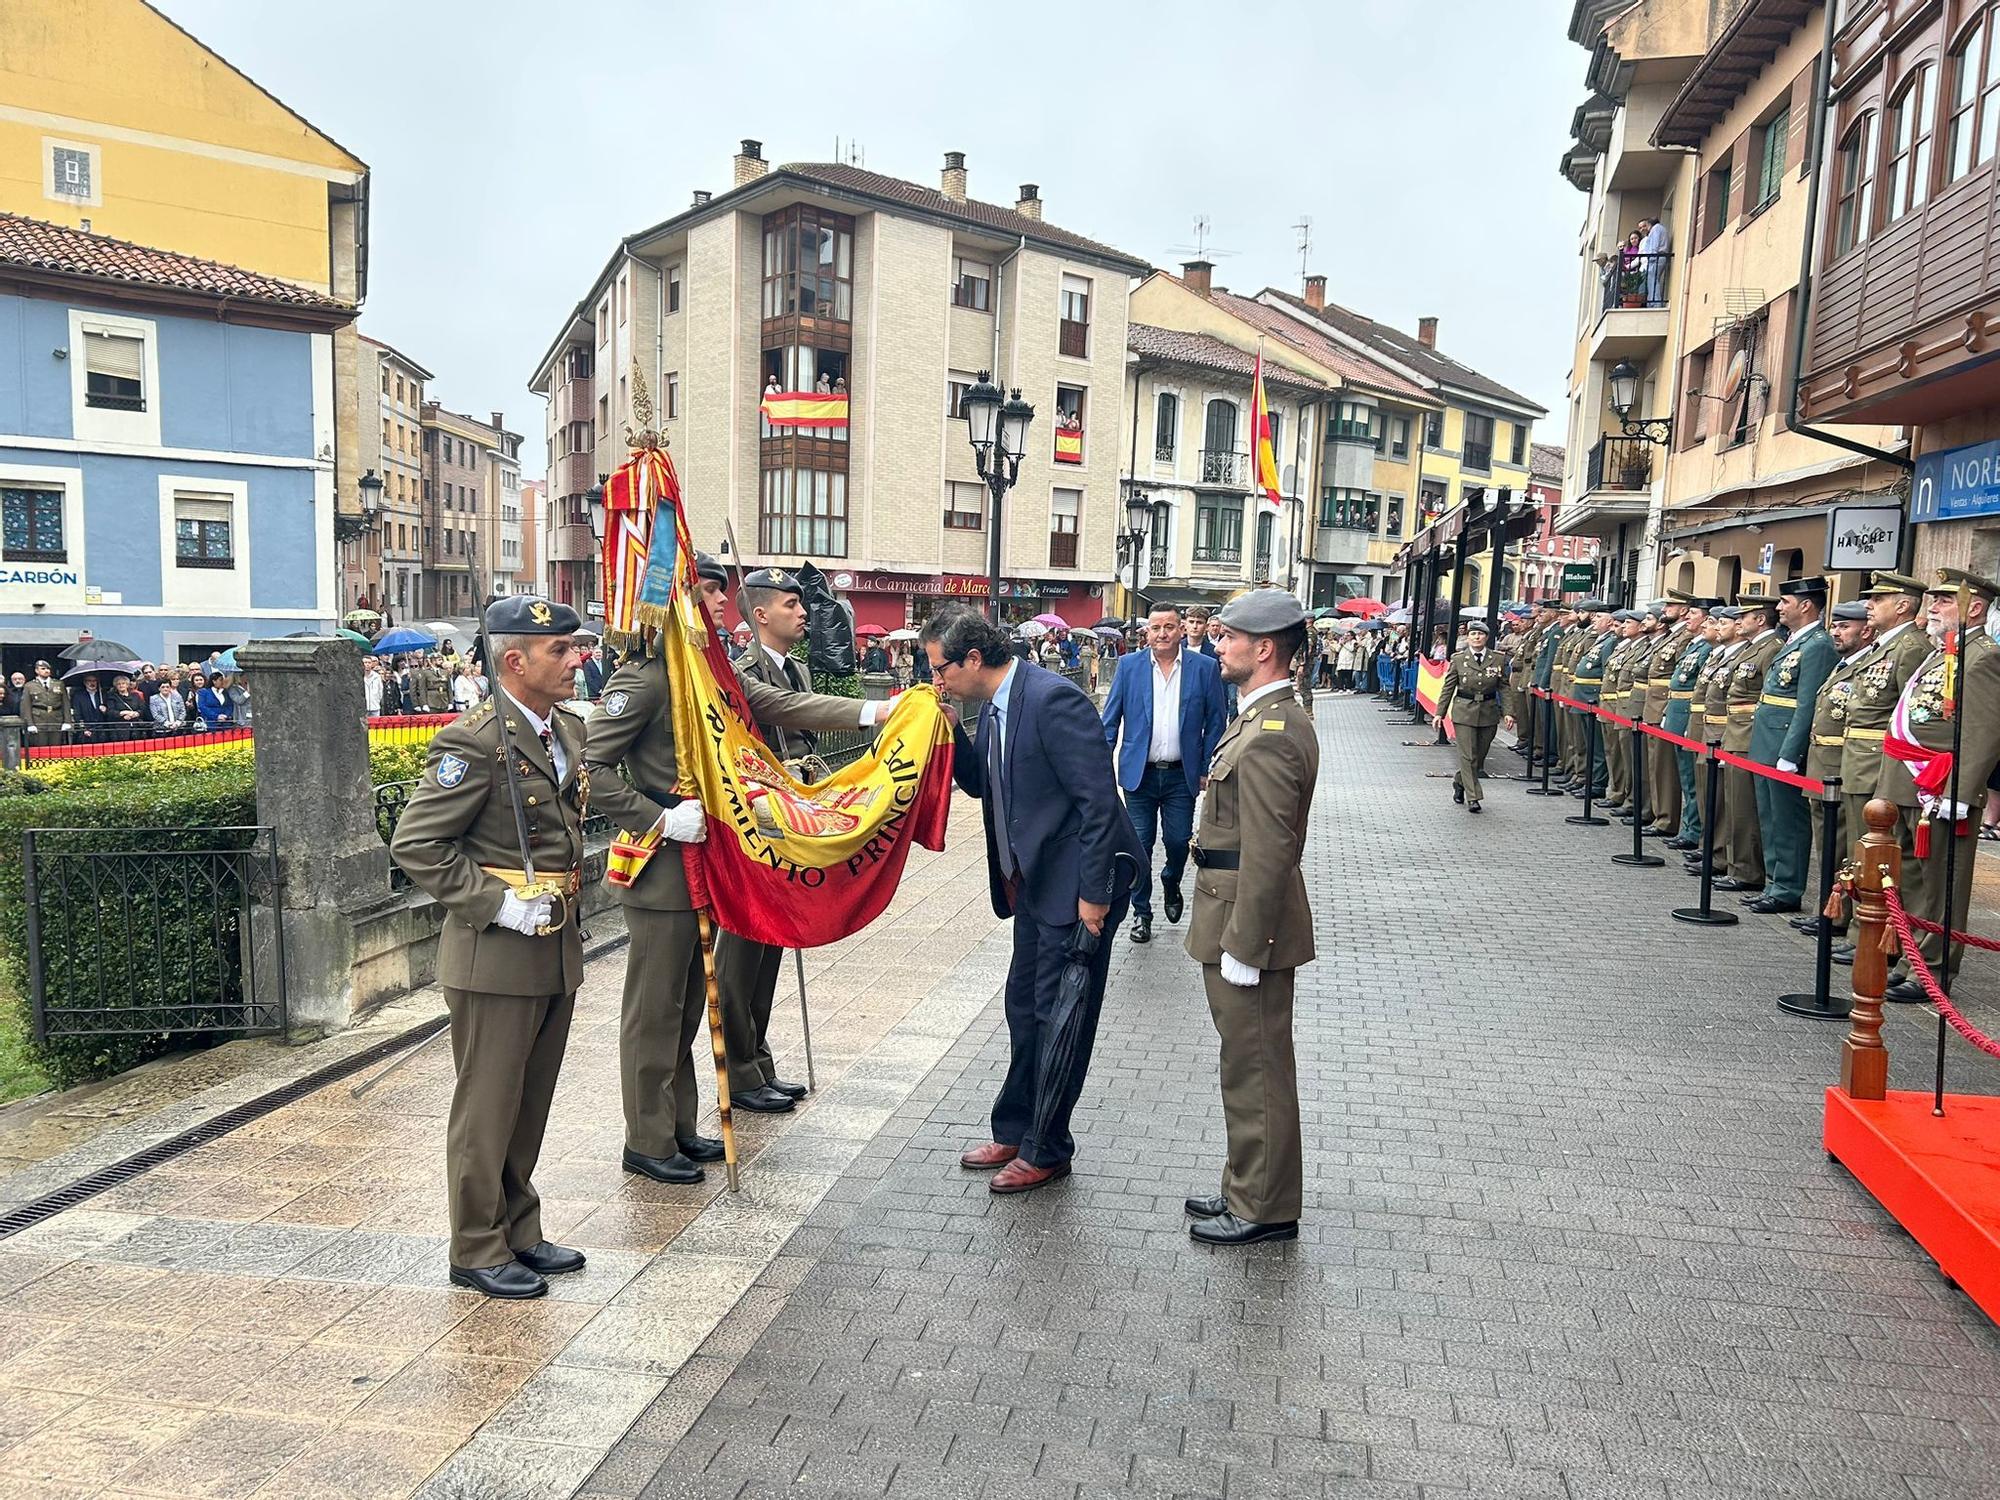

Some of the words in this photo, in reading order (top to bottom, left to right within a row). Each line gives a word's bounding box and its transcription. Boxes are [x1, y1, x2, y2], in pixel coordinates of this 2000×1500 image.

[1837, 530, 1893, 547] HATCHET
[855, 575, 872, 590] La
[944, 578, 957, 593] de
[706, 703, 825, 887] RIMIENTO
